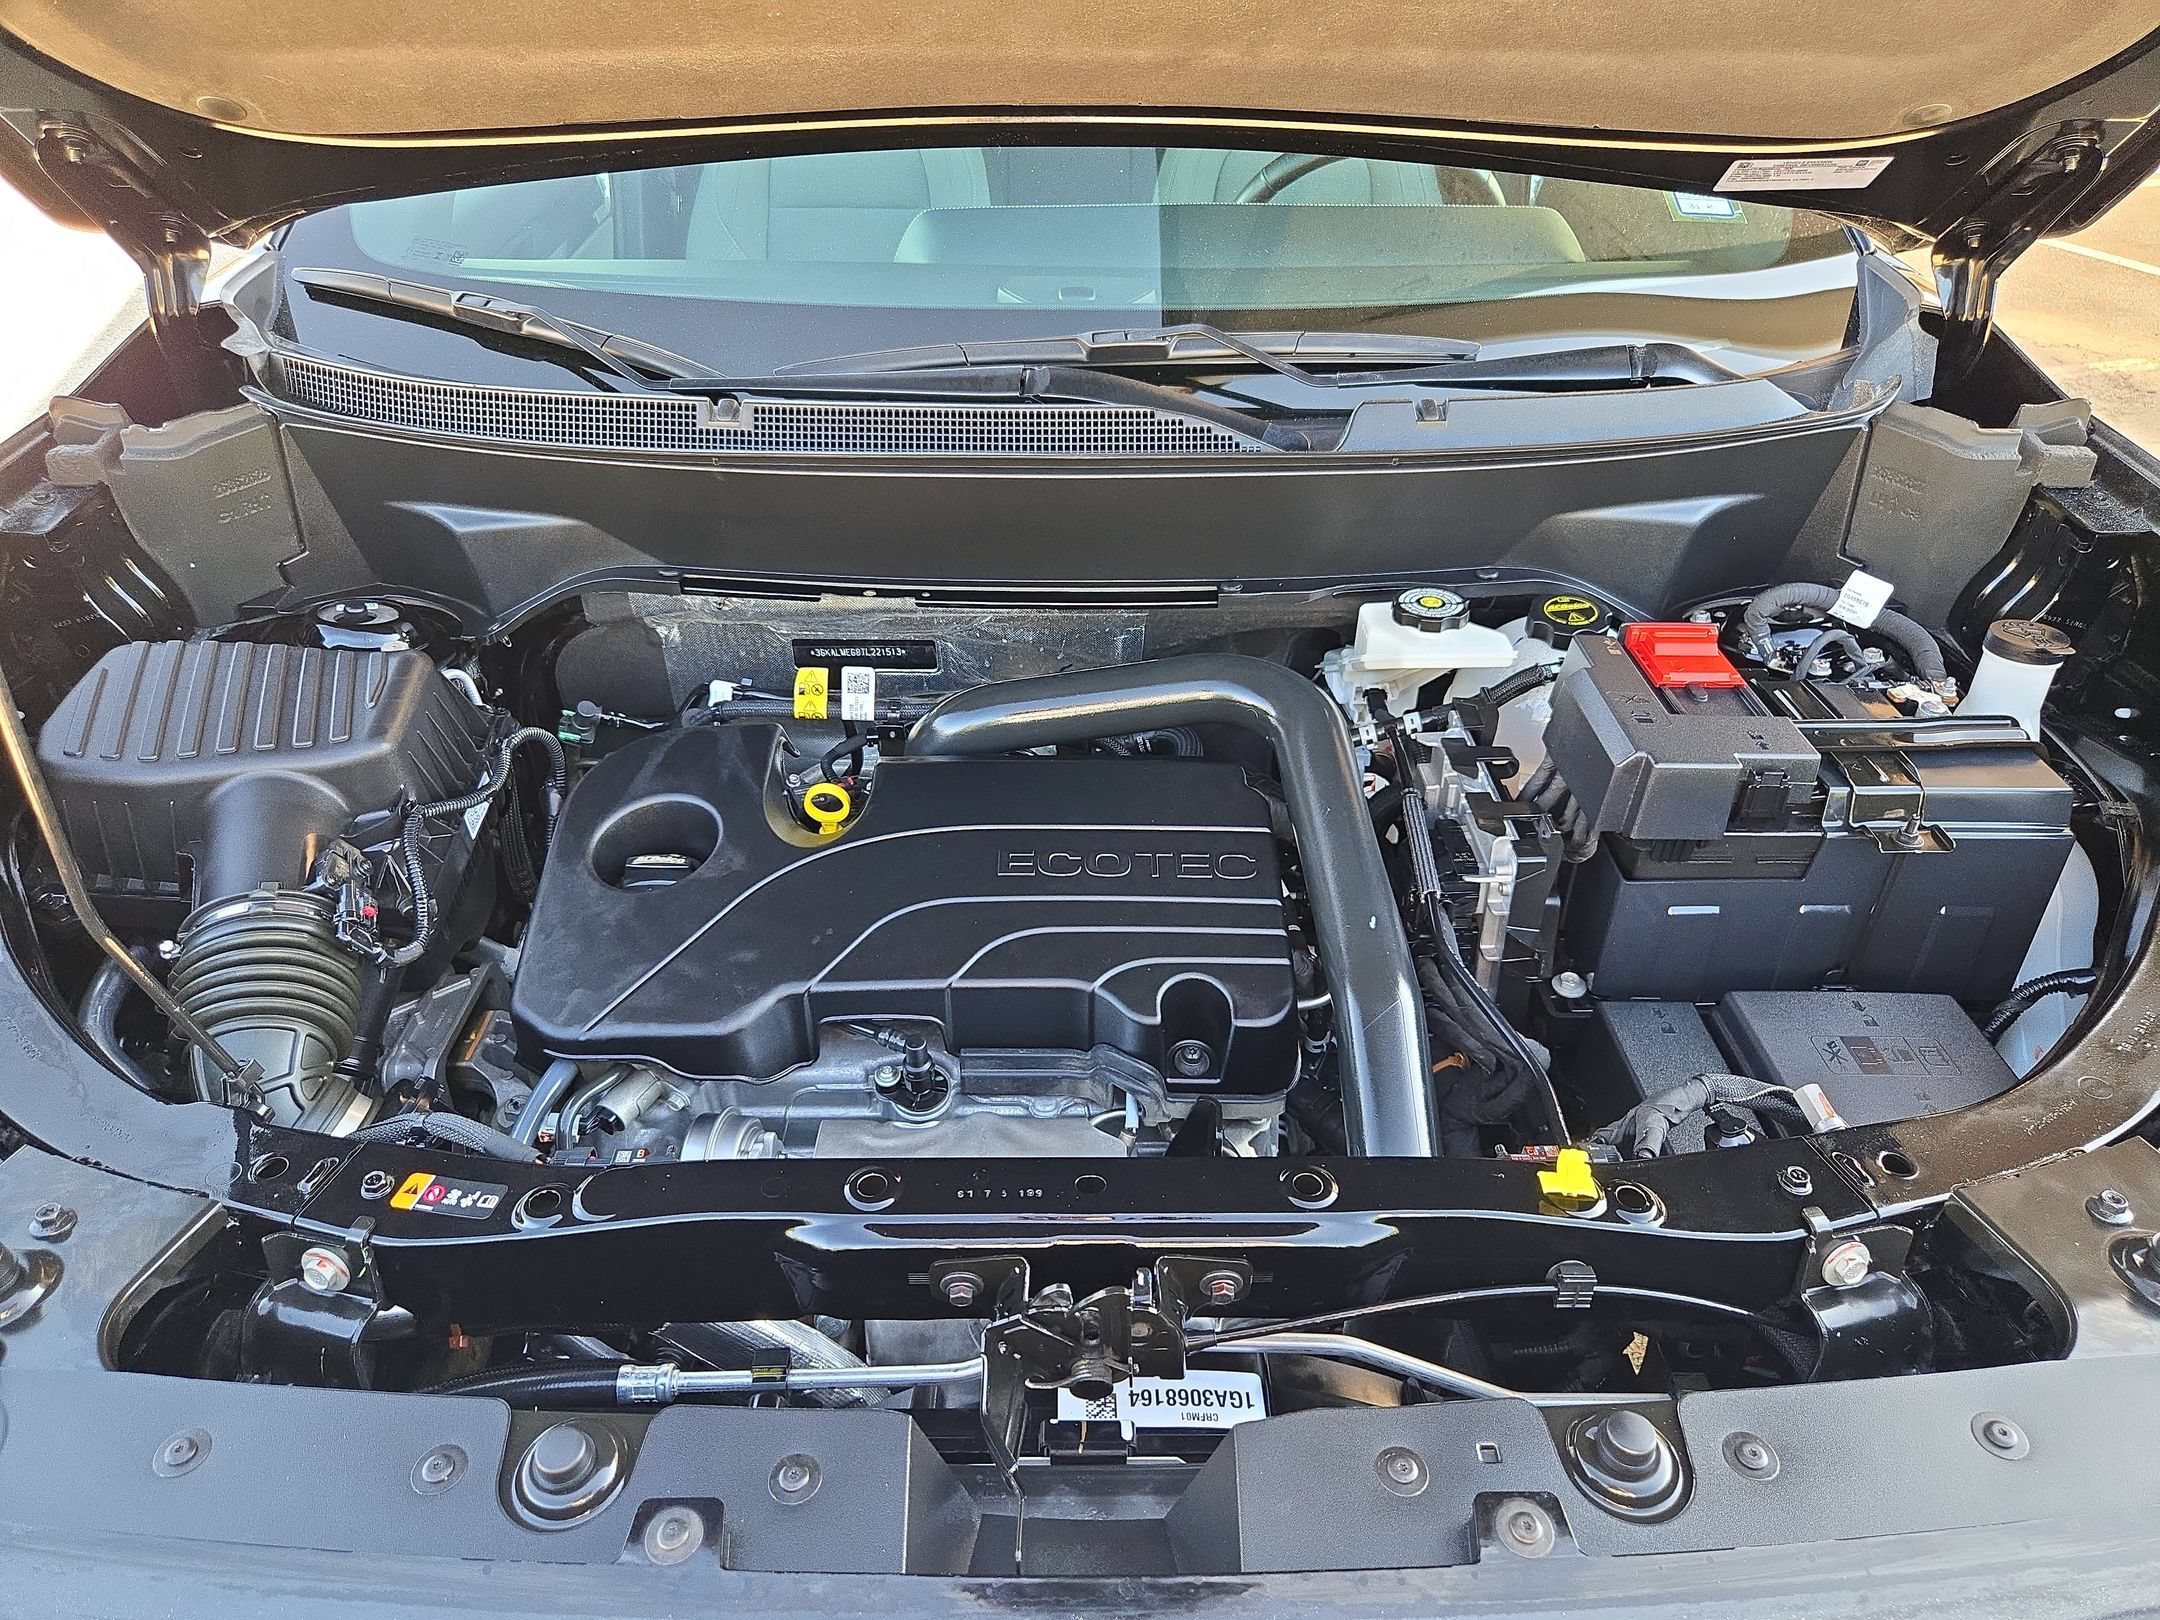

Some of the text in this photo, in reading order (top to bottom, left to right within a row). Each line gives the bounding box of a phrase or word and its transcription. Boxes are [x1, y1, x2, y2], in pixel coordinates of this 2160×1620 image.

[997, 849, 1258, 880] ECOTEC
[1128, 1388, 1256, 1410] 1GA3068164
[1181, 1411, 1219, 1422] CRFM01
